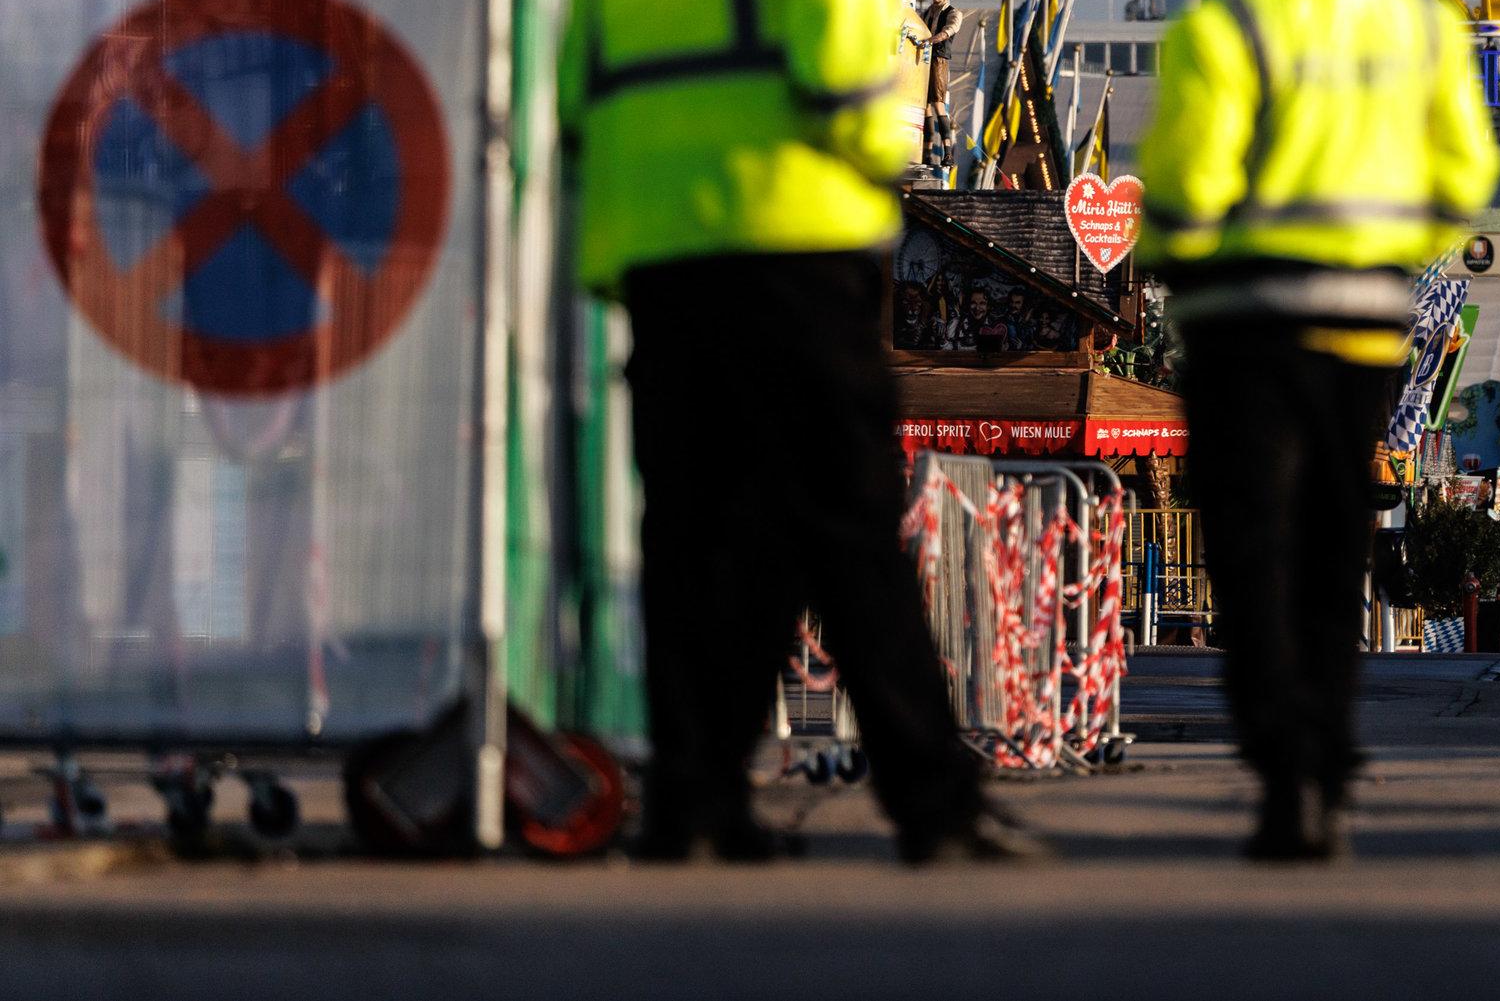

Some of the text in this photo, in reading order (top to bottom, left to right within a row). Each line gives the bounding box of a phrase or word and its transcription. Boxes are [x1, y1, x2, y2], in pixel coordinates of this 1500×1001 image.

[1071, 198, 1105, 216] Miris
[1080, 220, 1121, 233] Schnaps &
[1084, 232, 1121, 244] Cocktails
[895, 424, 1072, 439] APEROL SPRITZ WIESN MULE
[1122, 427, 1190, 438] SCHNAPS & COC
